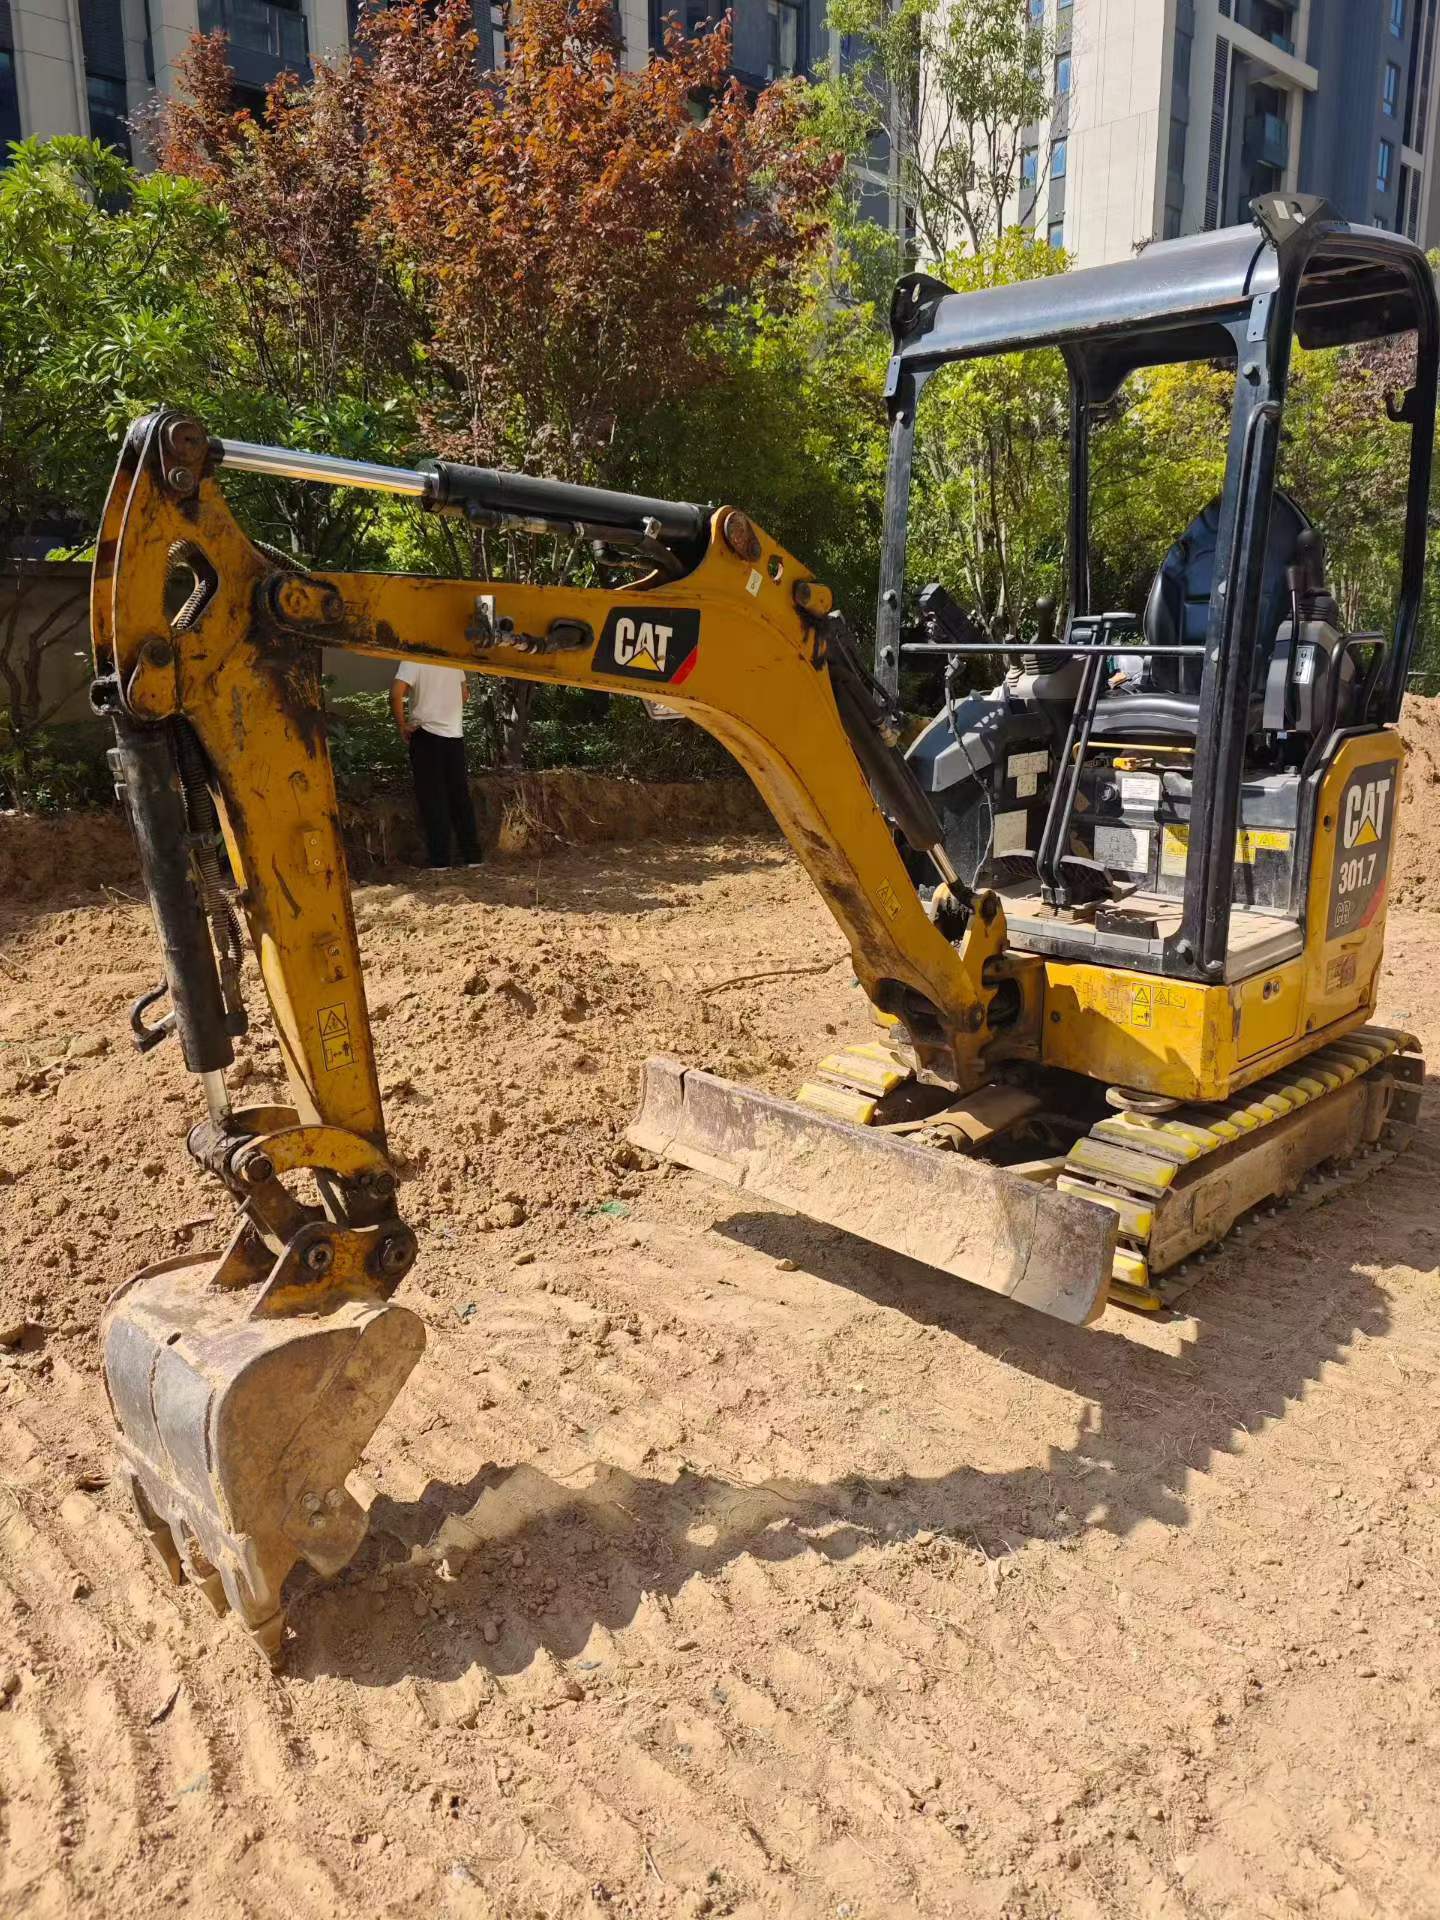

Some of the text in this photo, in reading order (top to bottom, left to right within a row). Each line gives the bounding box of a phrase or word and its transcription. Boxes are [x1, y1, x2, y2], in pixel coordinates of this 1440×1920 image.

[614, 617, 673, 672] CAT
[1344, 778, 1390, 848] CAT
[1338, 853, 1376, 895] 301.7
